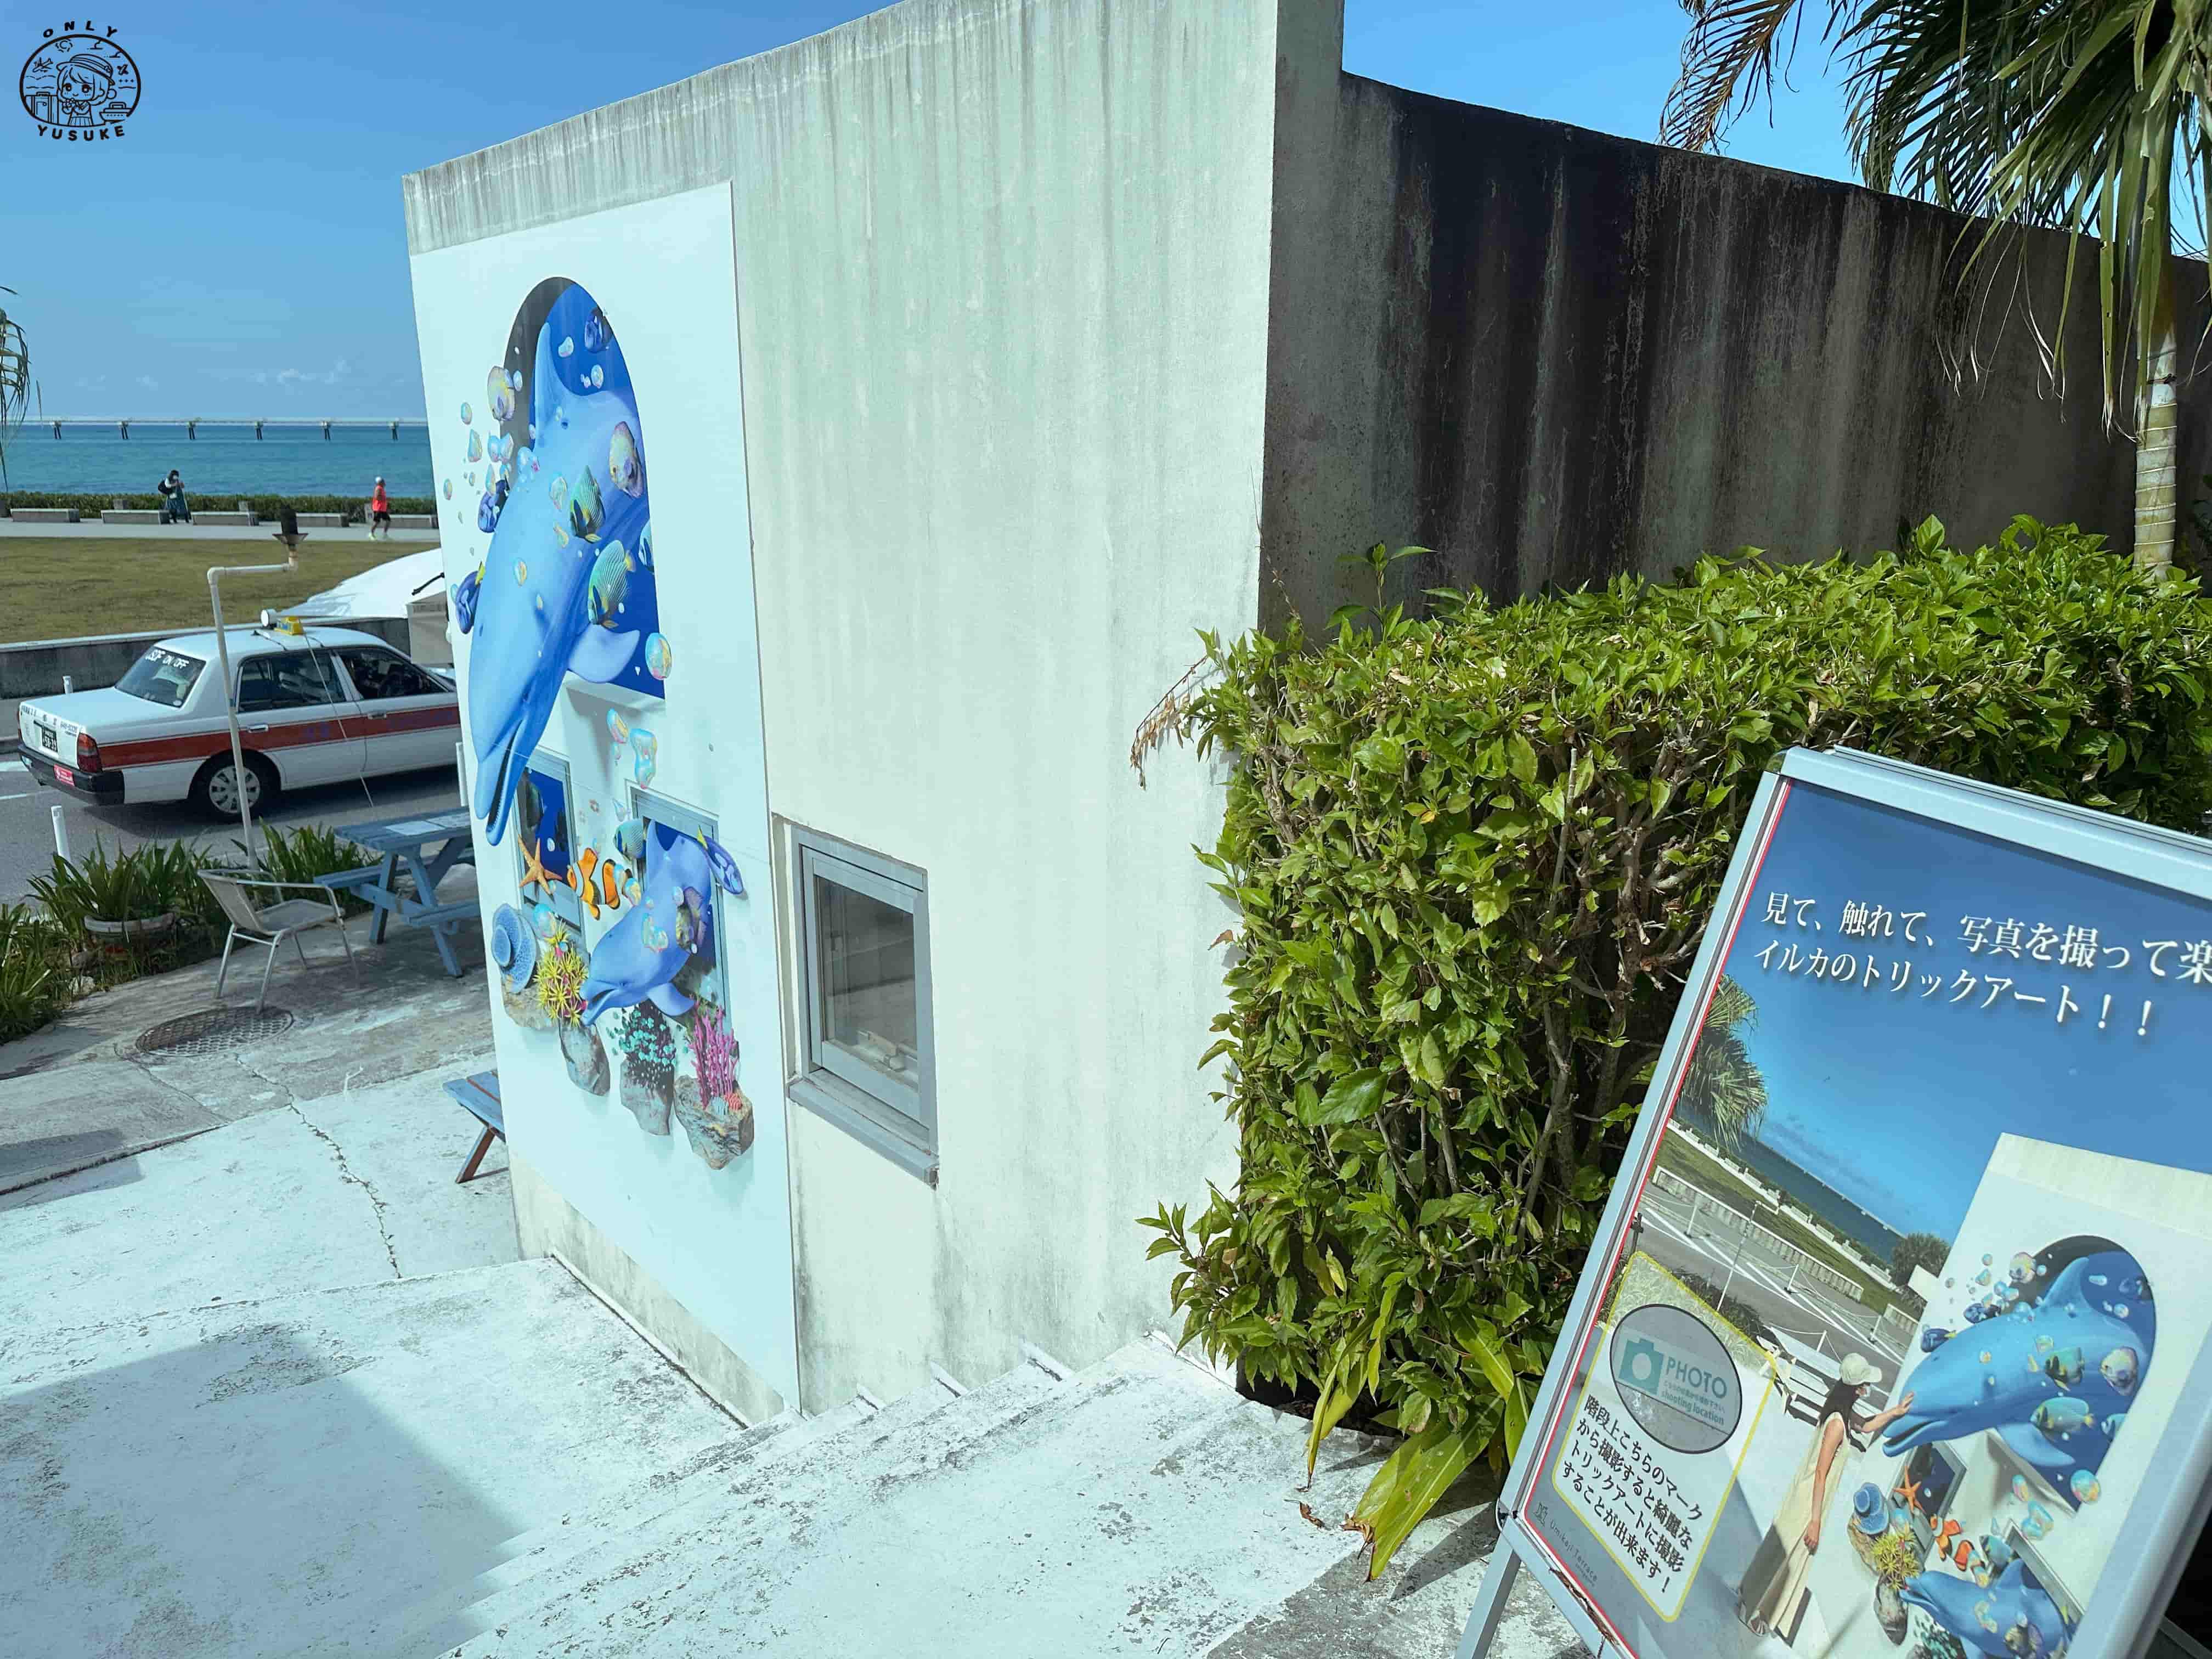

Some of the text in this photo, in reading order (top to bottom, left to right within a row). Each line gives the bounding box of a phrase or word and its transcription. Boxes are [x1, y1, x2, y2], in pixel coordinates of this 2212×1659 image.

[1661, 1391, 1724, 1425] shooting location
[1666, 1356, 1728, 1400] PHOTO
[1571, 1439, 1685, 1573] トリックアートに撮影
[1576, 1418, 1693, 1550] から撮影すると綺麗な
[1583, 1394, 1703, 1521] 階段上こちらのマーク
[1562, 1461, 1671, 1593] することが出来ます！
